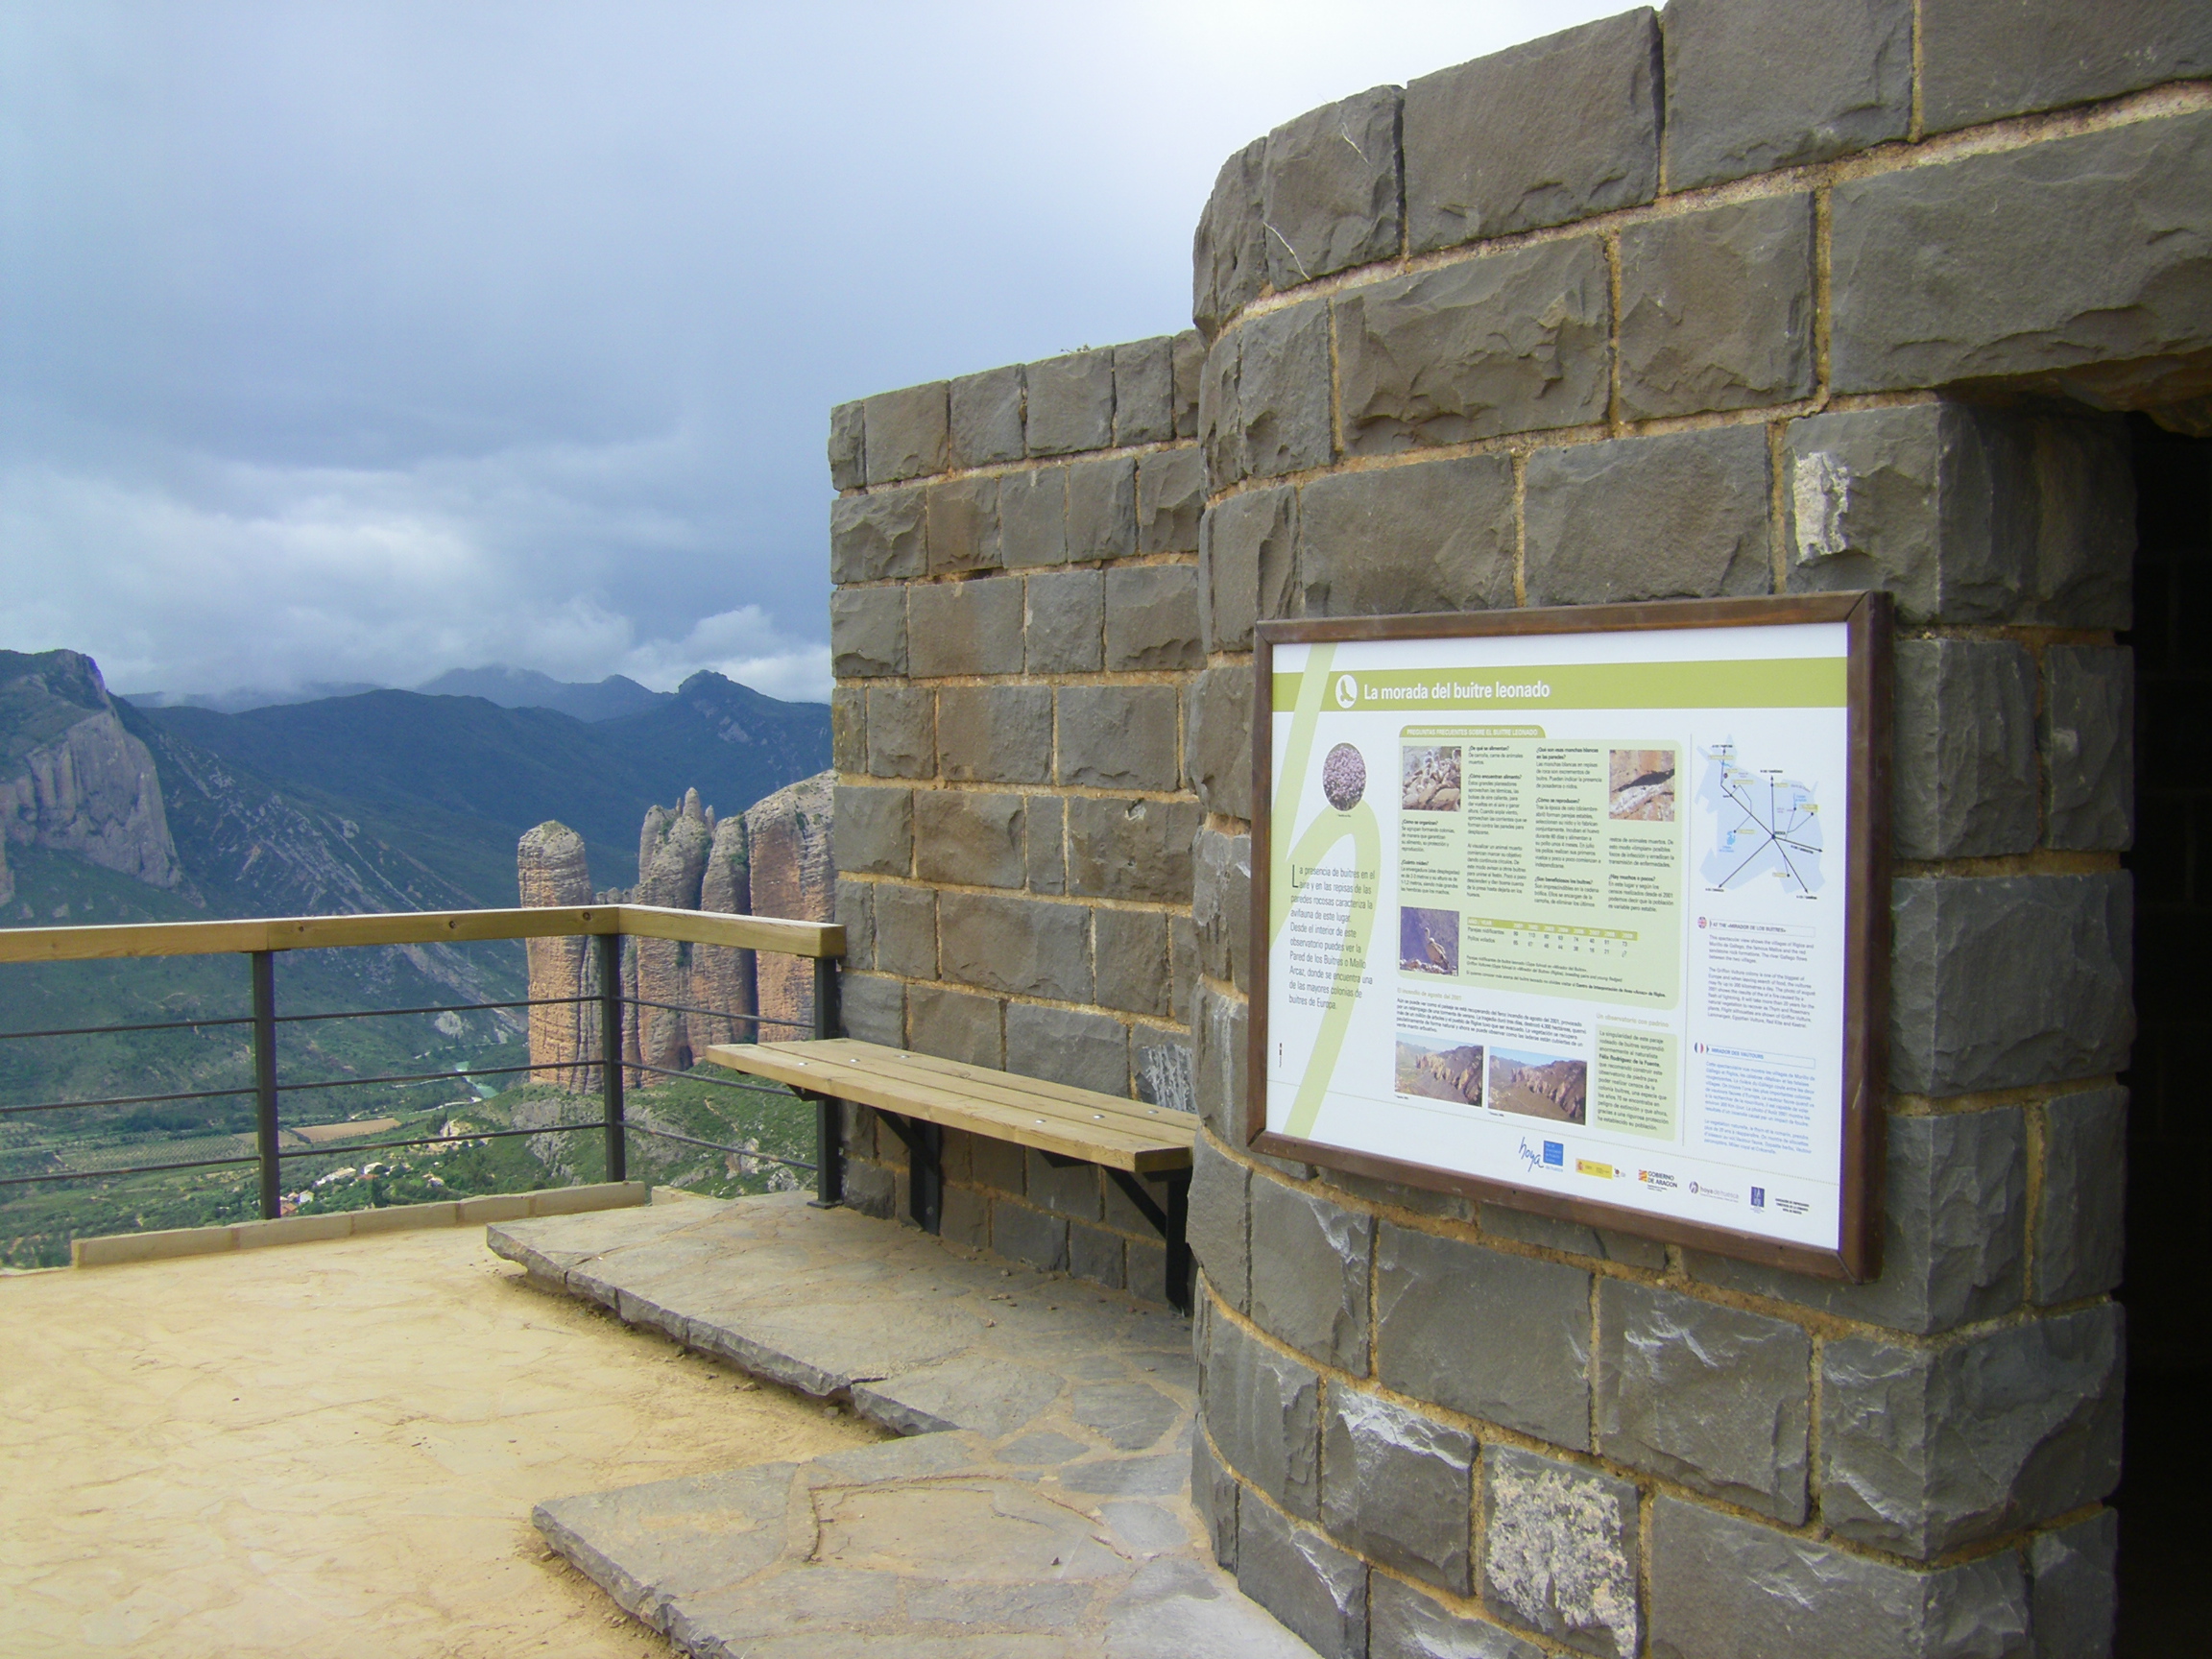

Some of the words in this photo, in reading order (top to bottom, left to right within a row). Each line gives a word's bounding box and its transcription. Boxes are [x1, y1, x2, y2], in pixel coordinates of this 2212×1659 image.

[1364, 684, 1379, 700] La
[1381, 683, 1429, 699] morada
[1431, 682, 1451, 699] del
[1454, 681, 1492, 699] buitre
[1496, 680, 1551, 698] leonado
[1304, 866, 1330, 877] presencia
[1332, 866, 1338, 877] de
[1340, 867, 1359, 879] buitres
[1369, 870, 1374, 880] el
[1299, 879, 1309, 890] aire
[1310, 882, 1314, 892] y
[1333, 882, 1352, 894] repisas
[1354, 883, 1361, 894] de
[1363, 884, 1371, 894] las
[1291, 894, 1311, 905] paredes
[1313, 897, 1334, 906] rocosas
[1335, 898, 1366, 909] caracteriza
[1367, 899, 1373, 910] la
[1290, 908, 1313, 919] avifauna
[1314, 909, 1321, 920] de
[1322, 910, 1334, 921] este
[1336, 911, 1350, 924] lugar.
[1290, 922, 1307, 933] Desde
[1308, 924, 1313, 934] el
[1315, 924, 1334, 936] interior
[1335, 926, 1342, 937] de
[1344, 927, 1357, 938] este
[1290, 937, 1323, 950] observatorio
[1324, 940, 1344, 952] puedes
[1345, 944, 1354, 952] ver
[1355, 943, 1361, 953] la
[1290, 950, 1305, 962] Pared
[1306, 952, 1313, 963] de
[1323, 954, 1343, 966] Buitres
[1349, 957, 1366, 969] Mallo
[1289, 965, 1305, 977] Arcaz,
[1307, 967, 1323, 979] donde
[1333, 972, 1360, 983] encuentra
[1362, 976, 1373, 985] una
[1289, 979, 1295, 990] de
[1306, 984, 1329, 995] mayores
[1330, 985, 1353, 997] colonias
[1354, 987, 1362, 998] de
[1289, 993, 1307, 1005] buitres
[1308, 995, 1315, 1006] de
[1316, 997, 1336, 1011] Europa.
[1518, 1136, 1544, 1172] hoya
[1647, 1170, 1674, 1181] GOBIERNO
